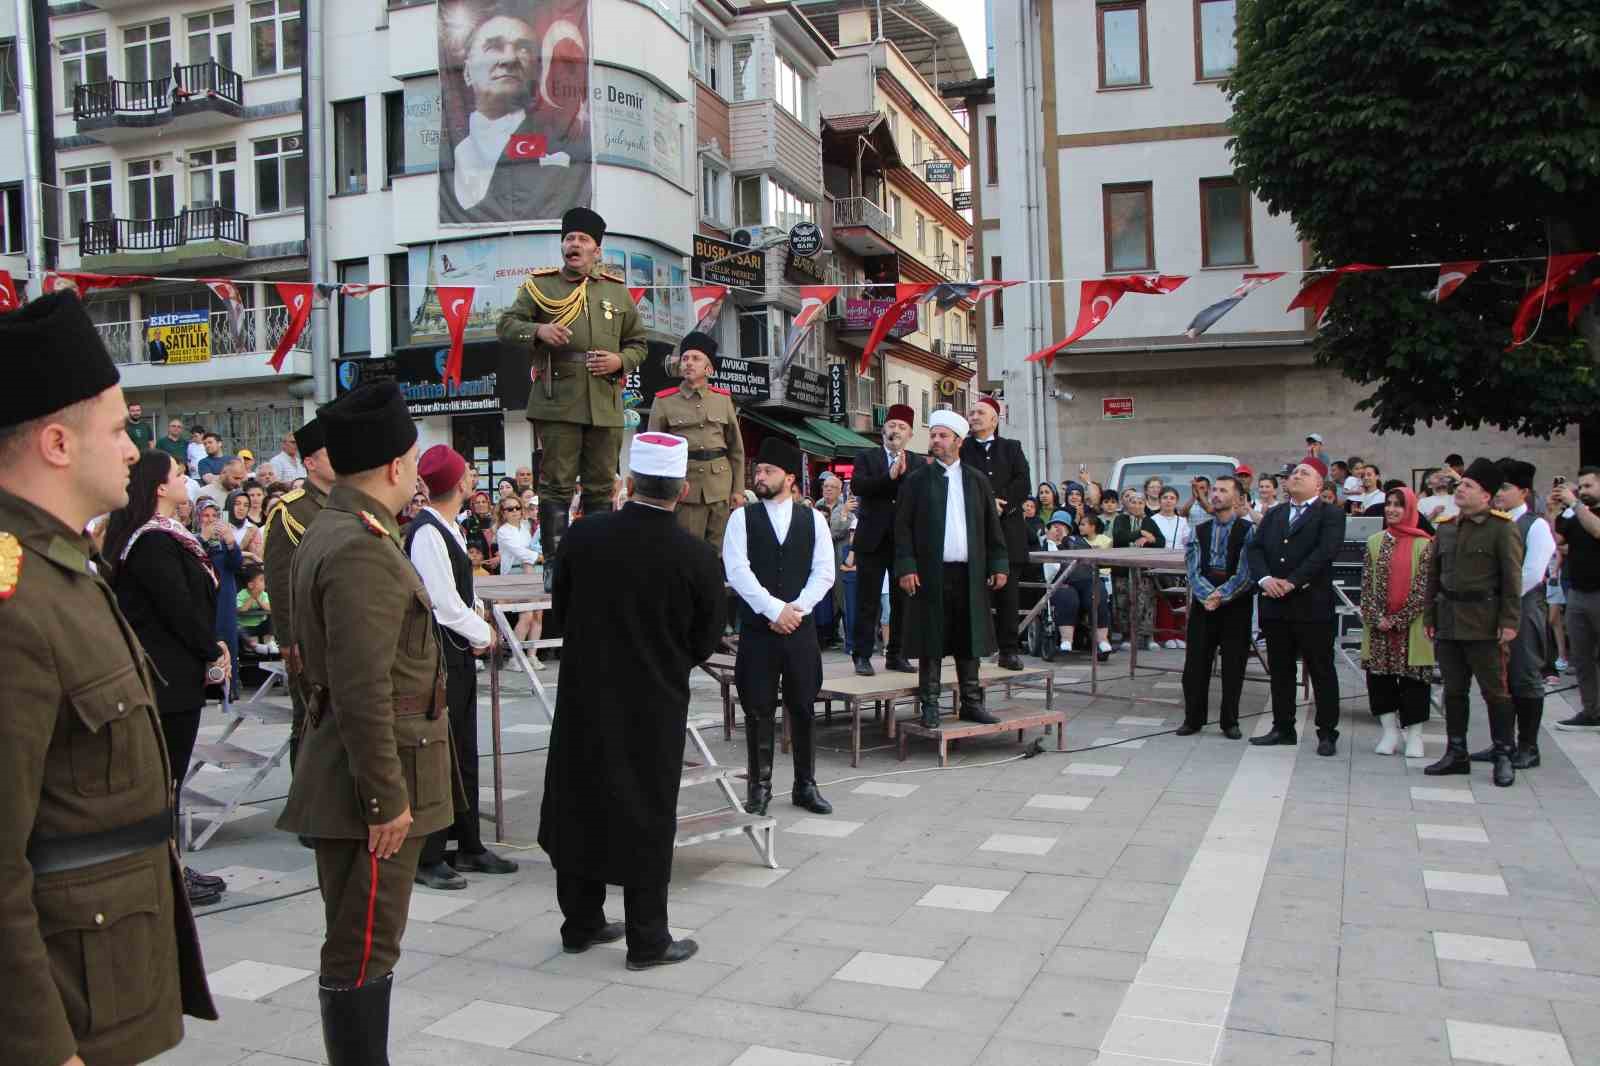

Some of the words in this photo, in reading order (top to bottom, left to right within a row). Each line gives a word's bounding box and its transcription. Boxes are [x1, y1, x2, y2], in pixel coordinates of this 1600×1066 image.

[607, 85, 643, 110] Demir
[166, 332, 208, 350] SATILIK
[721, 359, 748, 371] AVUKAT
[832, 365, 841, 413] AVUKAT
